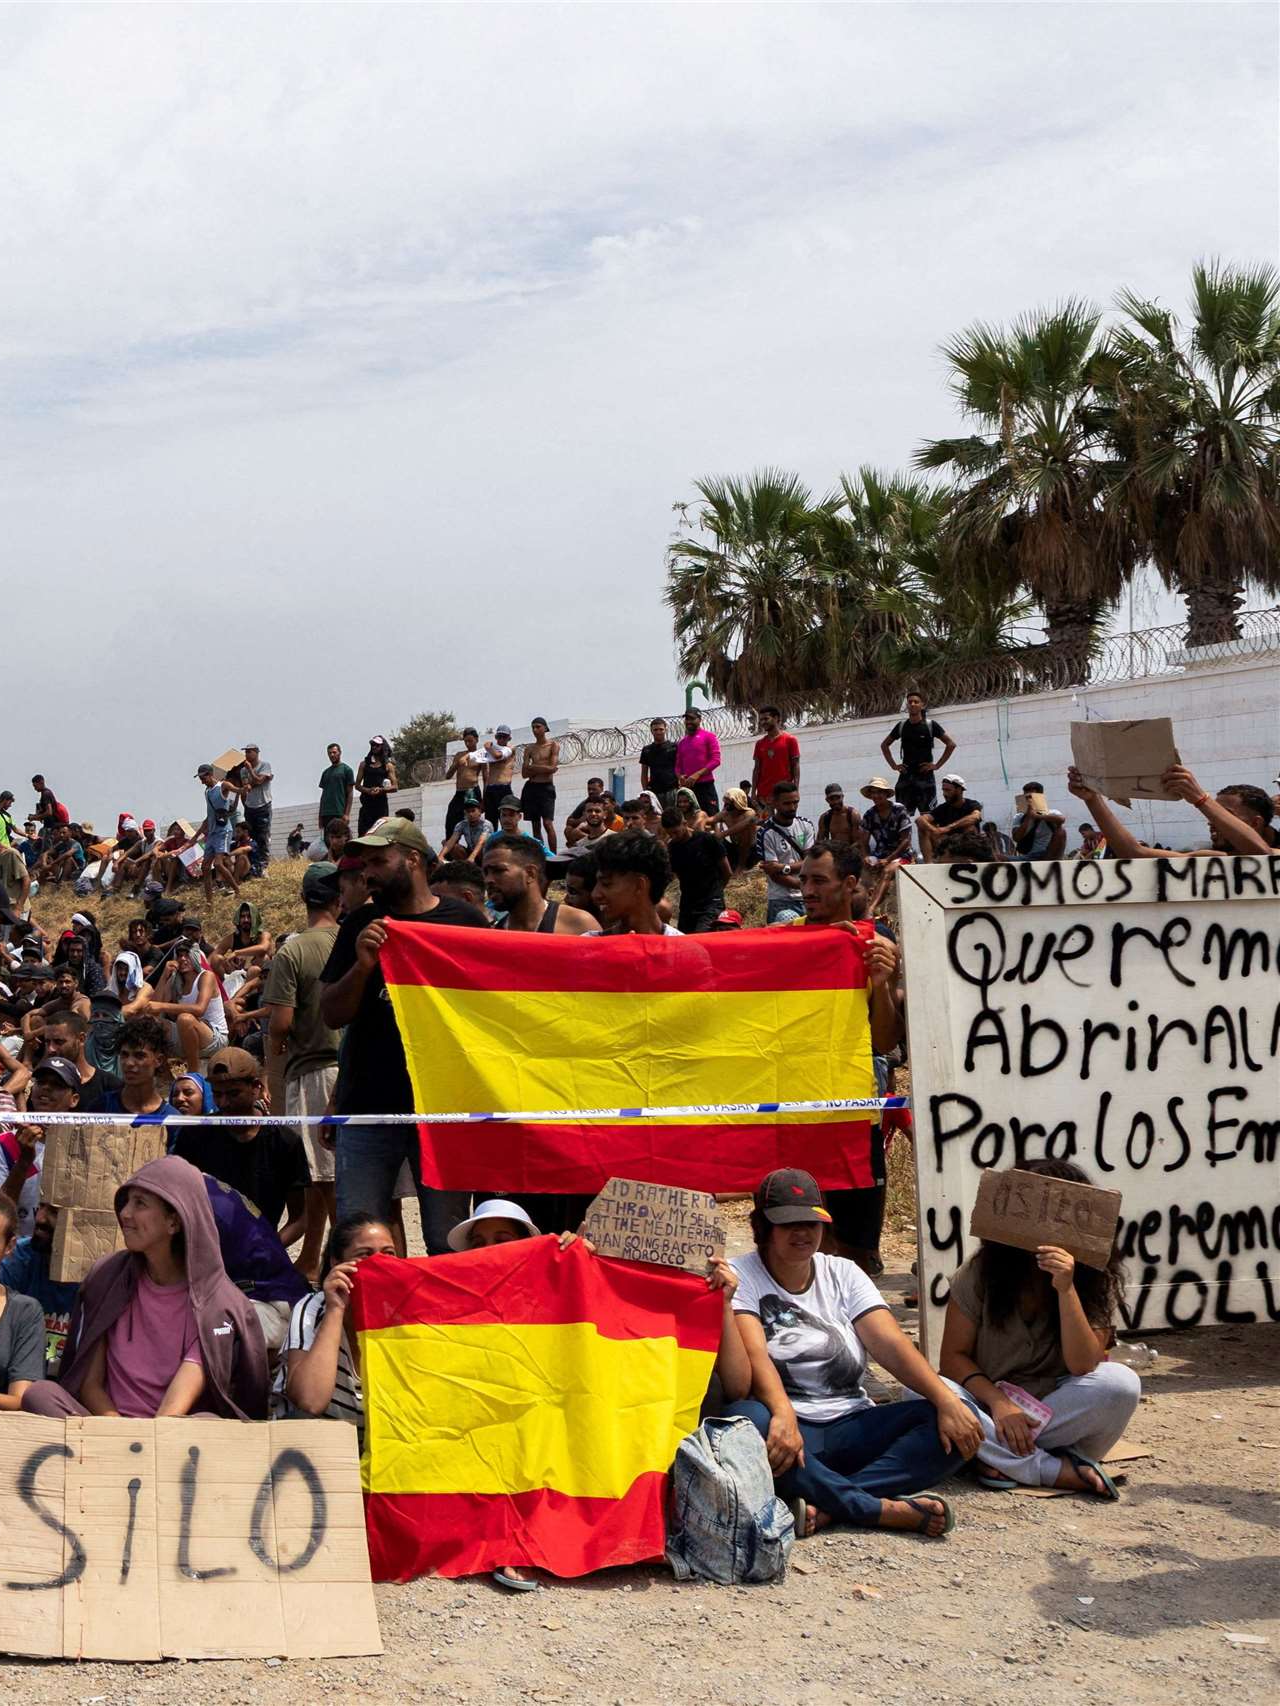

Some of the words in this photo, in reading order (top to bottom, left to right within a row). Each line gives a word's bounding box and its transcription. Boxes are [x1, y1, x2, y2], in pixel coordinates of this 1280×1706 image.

[949, 859, 1134, 905] SOMOS
[947, 911, 1280, 1013] Querem
[635, 1184, 700, 1209] RATHER
[601, 1198, 666, 1221] THROW
[589, 1213, 610, 1229] AT
[612, 1216, 640, 1234] THE
[624, 1235, 660, 1250] GOING
[623, 1247, 686, 1266] MOROCCO
